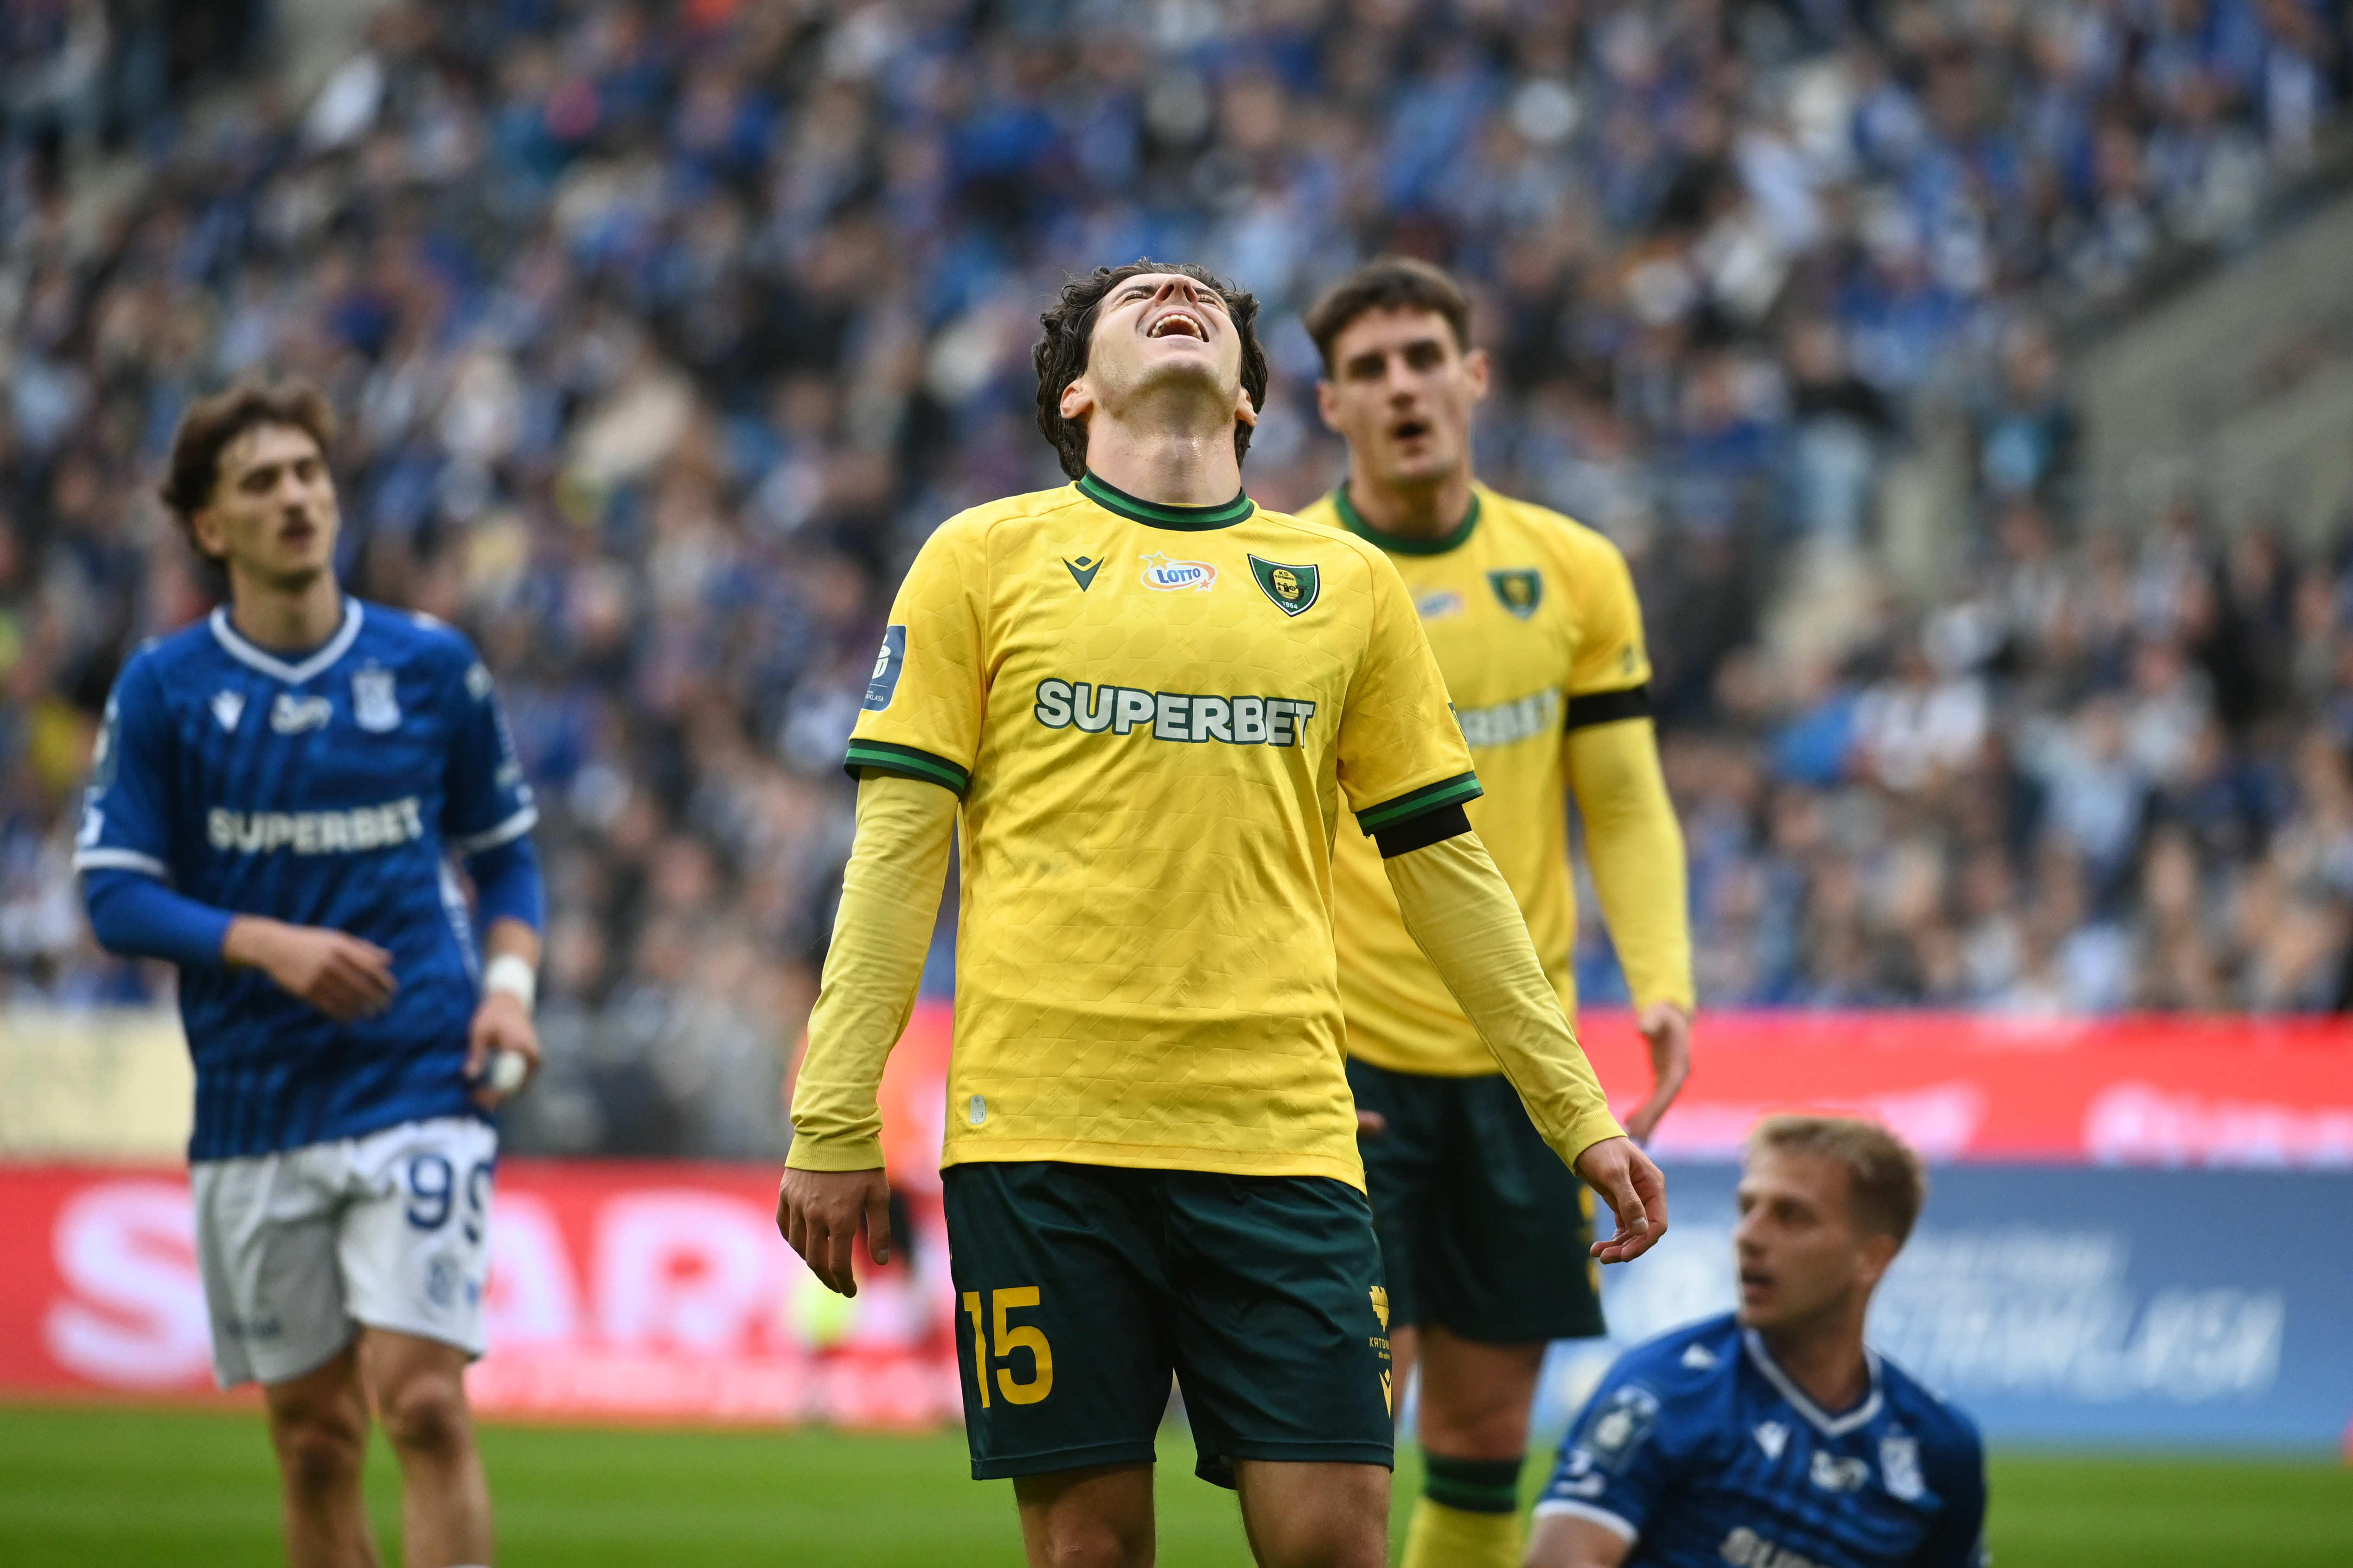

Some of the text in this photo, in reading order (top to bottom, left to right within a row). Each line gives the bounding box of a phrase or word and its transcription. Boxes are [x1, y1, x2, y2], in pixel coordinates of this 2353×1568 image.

[1156, 567, 1201, 583] LOTTO
[1035, 678, 1316, 748] SUPERBET
[207, 796, 423, 856] SUPERBET
[963, 1286, 1053, 1408] 15
